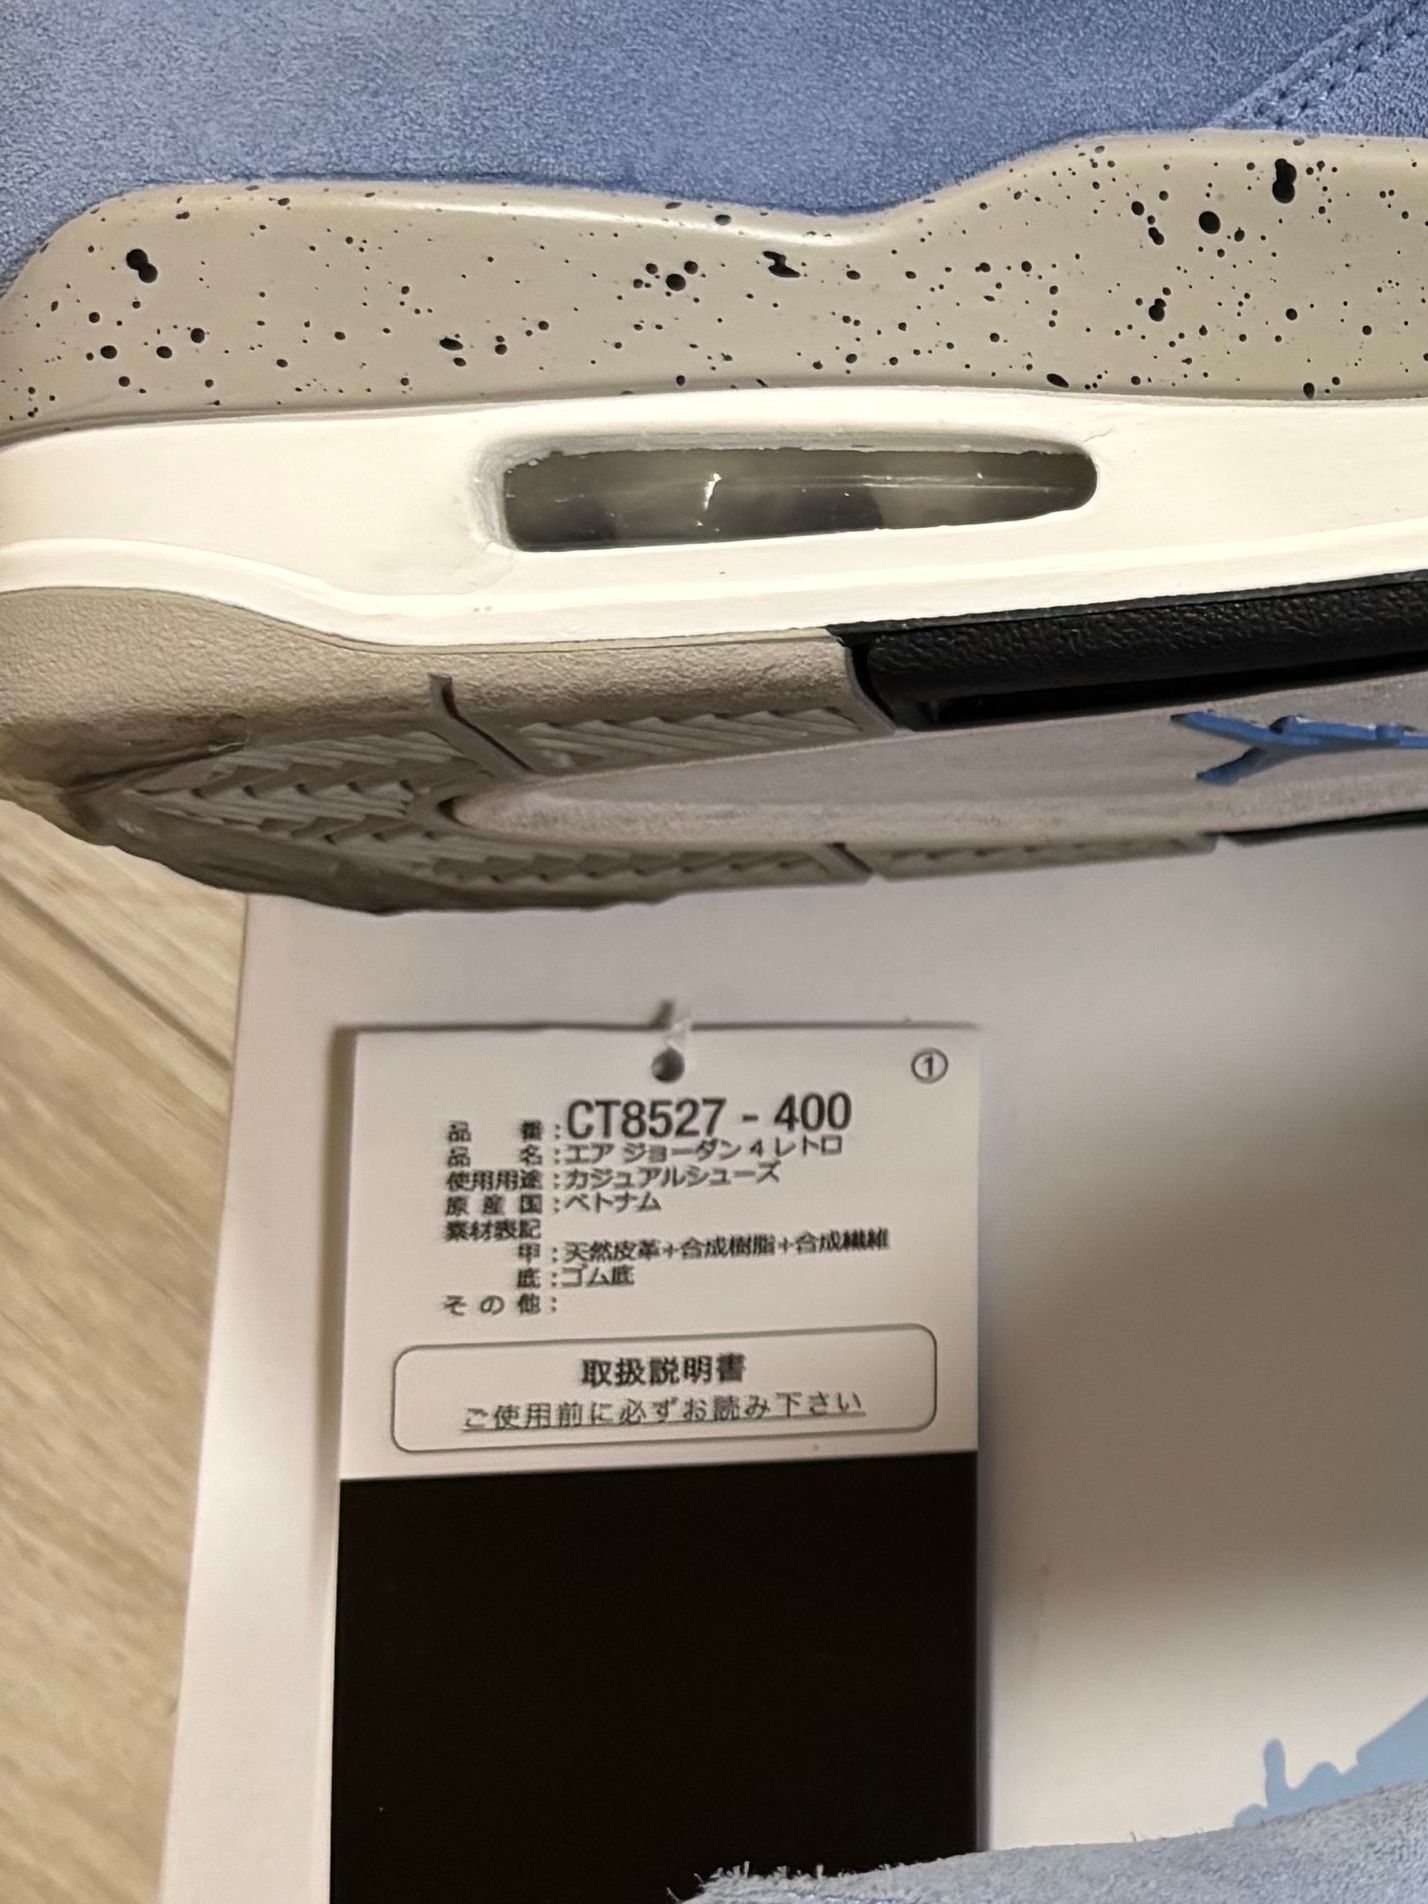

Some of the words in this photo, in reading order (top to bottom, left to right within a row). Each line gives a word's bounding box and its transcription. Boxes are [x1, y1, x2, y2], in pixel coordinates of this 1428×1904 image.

[581, 1352, 747, 1388] 取扱説明書
[464, 1391, 862, 1430] ご使用前に必ずお読み下さい
